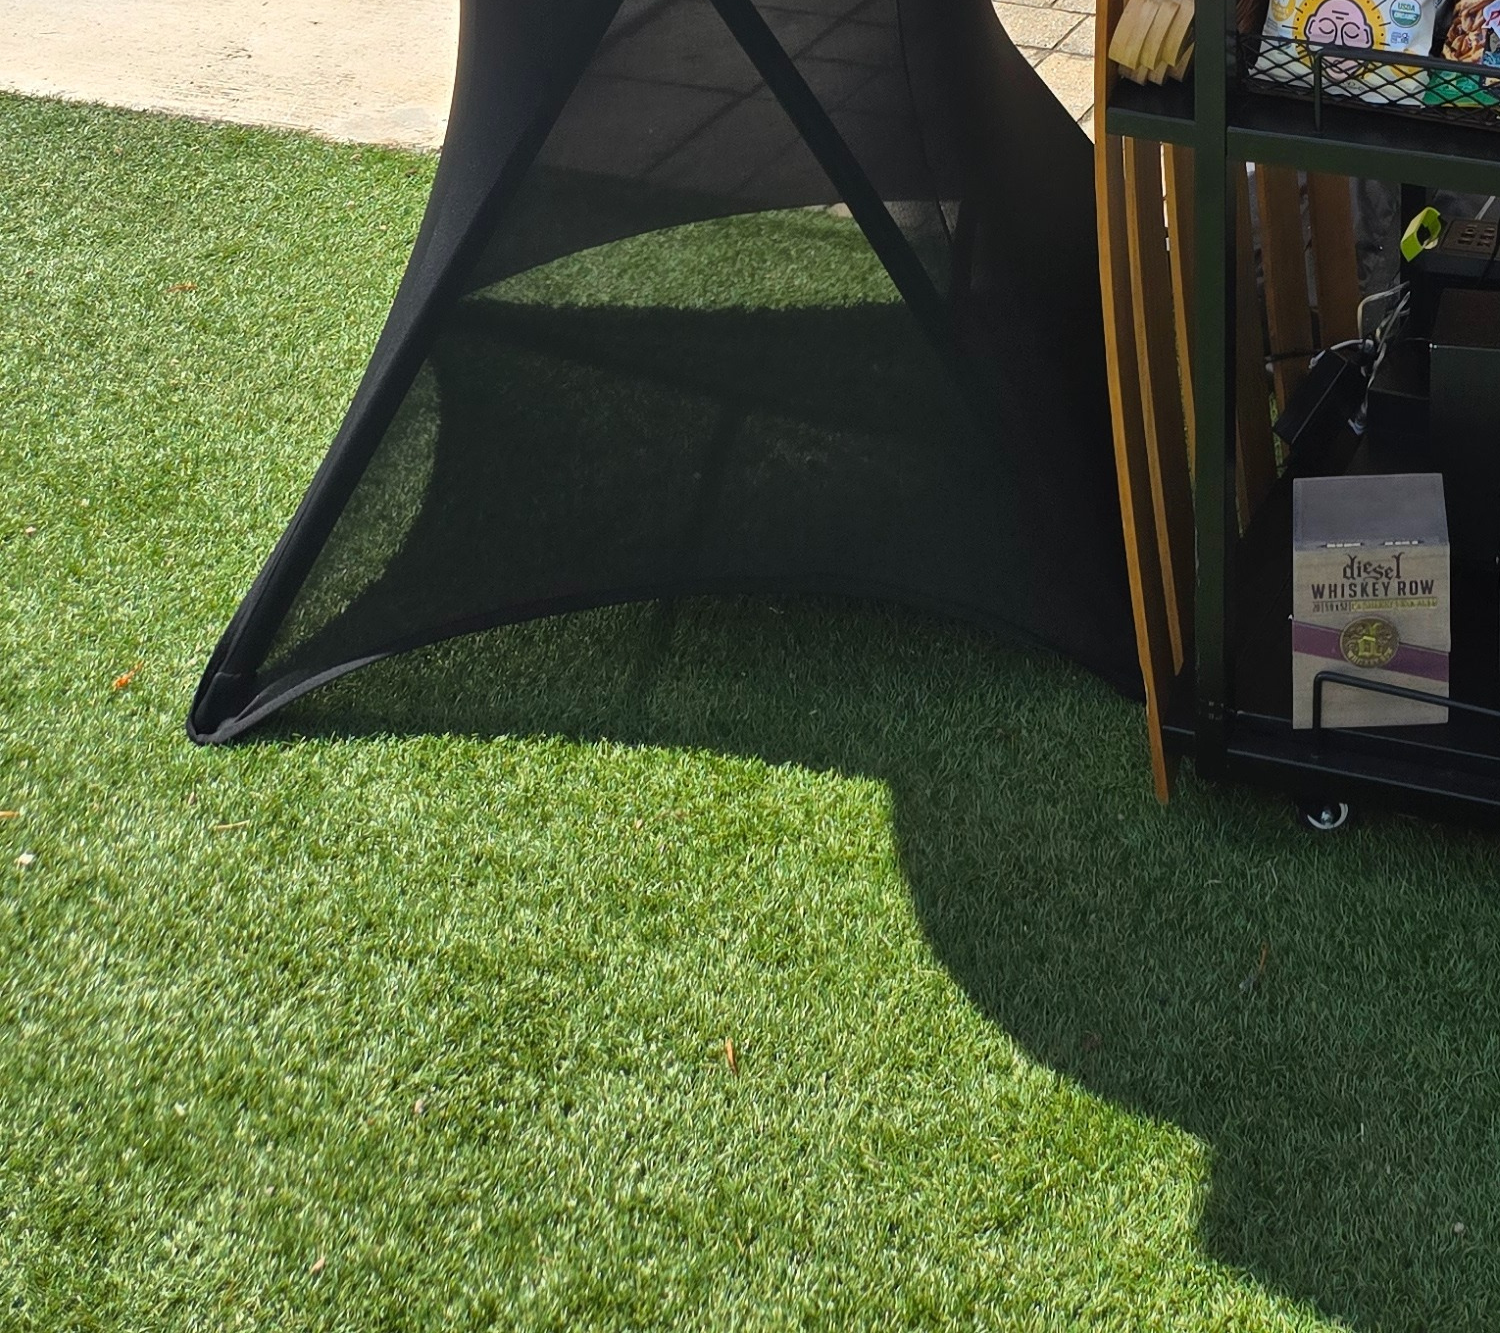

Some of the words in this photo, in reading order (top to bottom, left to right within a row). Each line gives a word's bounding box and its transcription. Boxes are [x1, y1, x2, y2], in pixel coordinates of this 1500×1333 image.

[1342, 551, 1405, 581] diesel
[1311, 581, 1391, 600] WHISKEY
[1397, 579, 1435, 596] ROW
